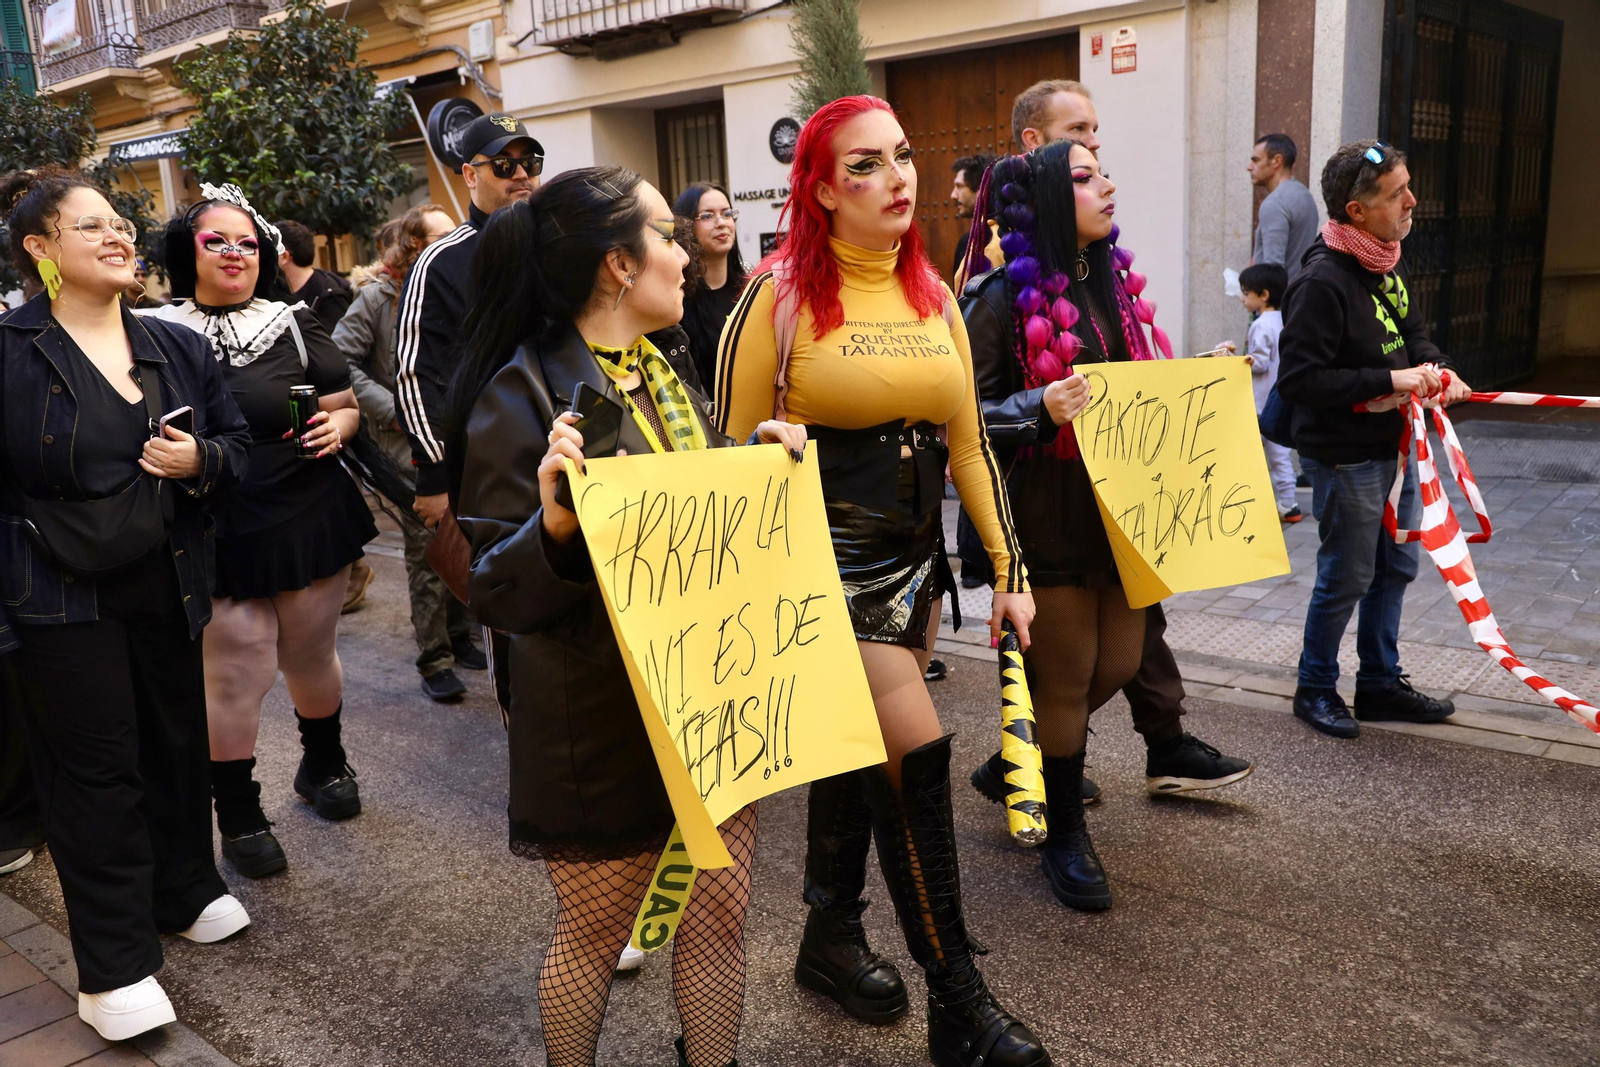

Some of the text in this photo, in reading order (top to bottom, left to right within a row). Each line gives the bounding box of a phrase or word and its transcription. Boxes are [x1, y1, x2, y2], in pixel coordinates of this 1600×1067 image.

[734, 187, 792, 202] MASSAGE UN
[850, 333, 932, 346] QUENTIN
[875, 321, 892, 329] AND
[892, 319, 926, 329] DIRECTED
[838, 344, 950, 358] TARANTINO
[1079, 370, 1226, 467] PAKITO TE
[757, 475, 791, 557] LA
[1153, 480, 1256, 551] DRAG
[713, 602, 756, 685] ES
[772, 593, 827, 657] DE
